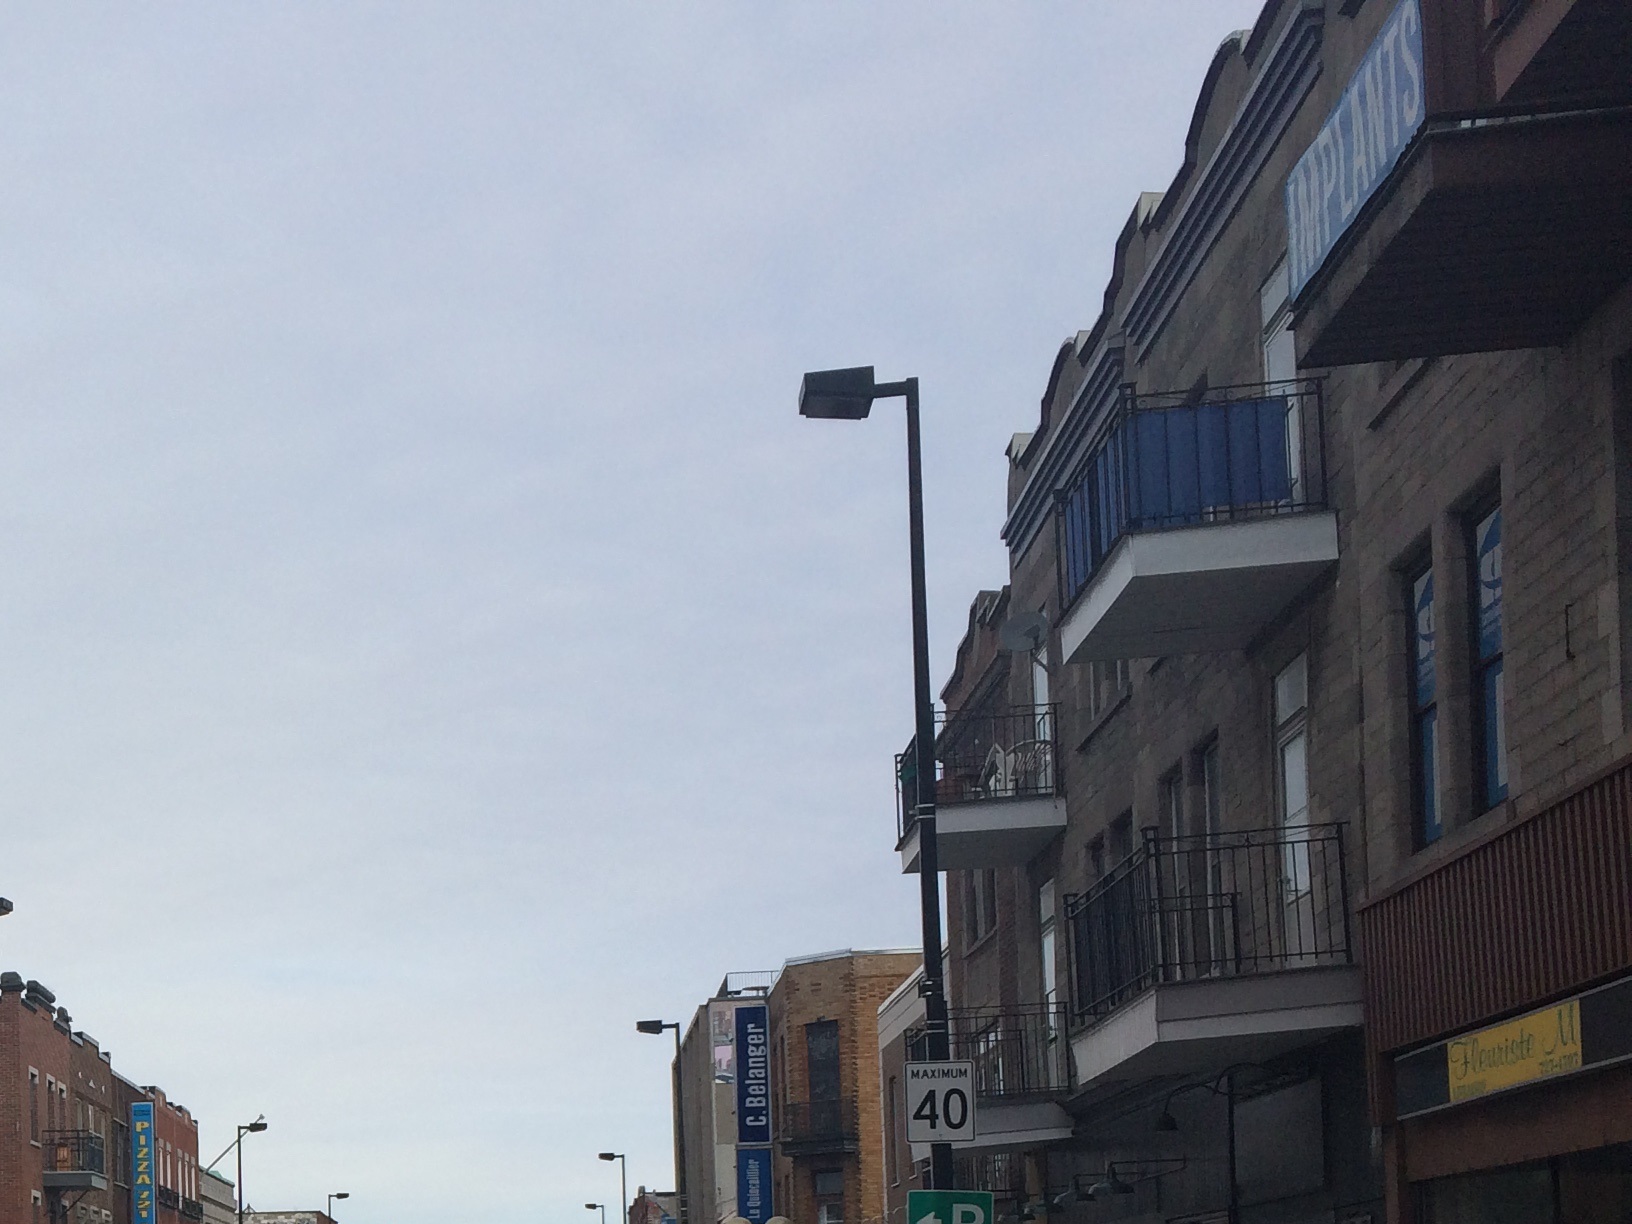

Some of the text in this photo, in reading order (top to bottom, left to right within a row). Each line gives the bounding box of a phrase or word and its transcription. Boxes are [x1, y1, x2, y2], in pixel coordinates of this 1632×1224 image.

[1288, 0, 1419, 289] IMPLANTS
[744, 1023, 767, 1107] Belanger
[910, 1067, 967, 1079] MAXIMUM
[1448, 1027, 1535, 1081] Fleuriste
[913, 1088, 968, 1129] 40
[135, 1121, 151, 1185] PIZZA
